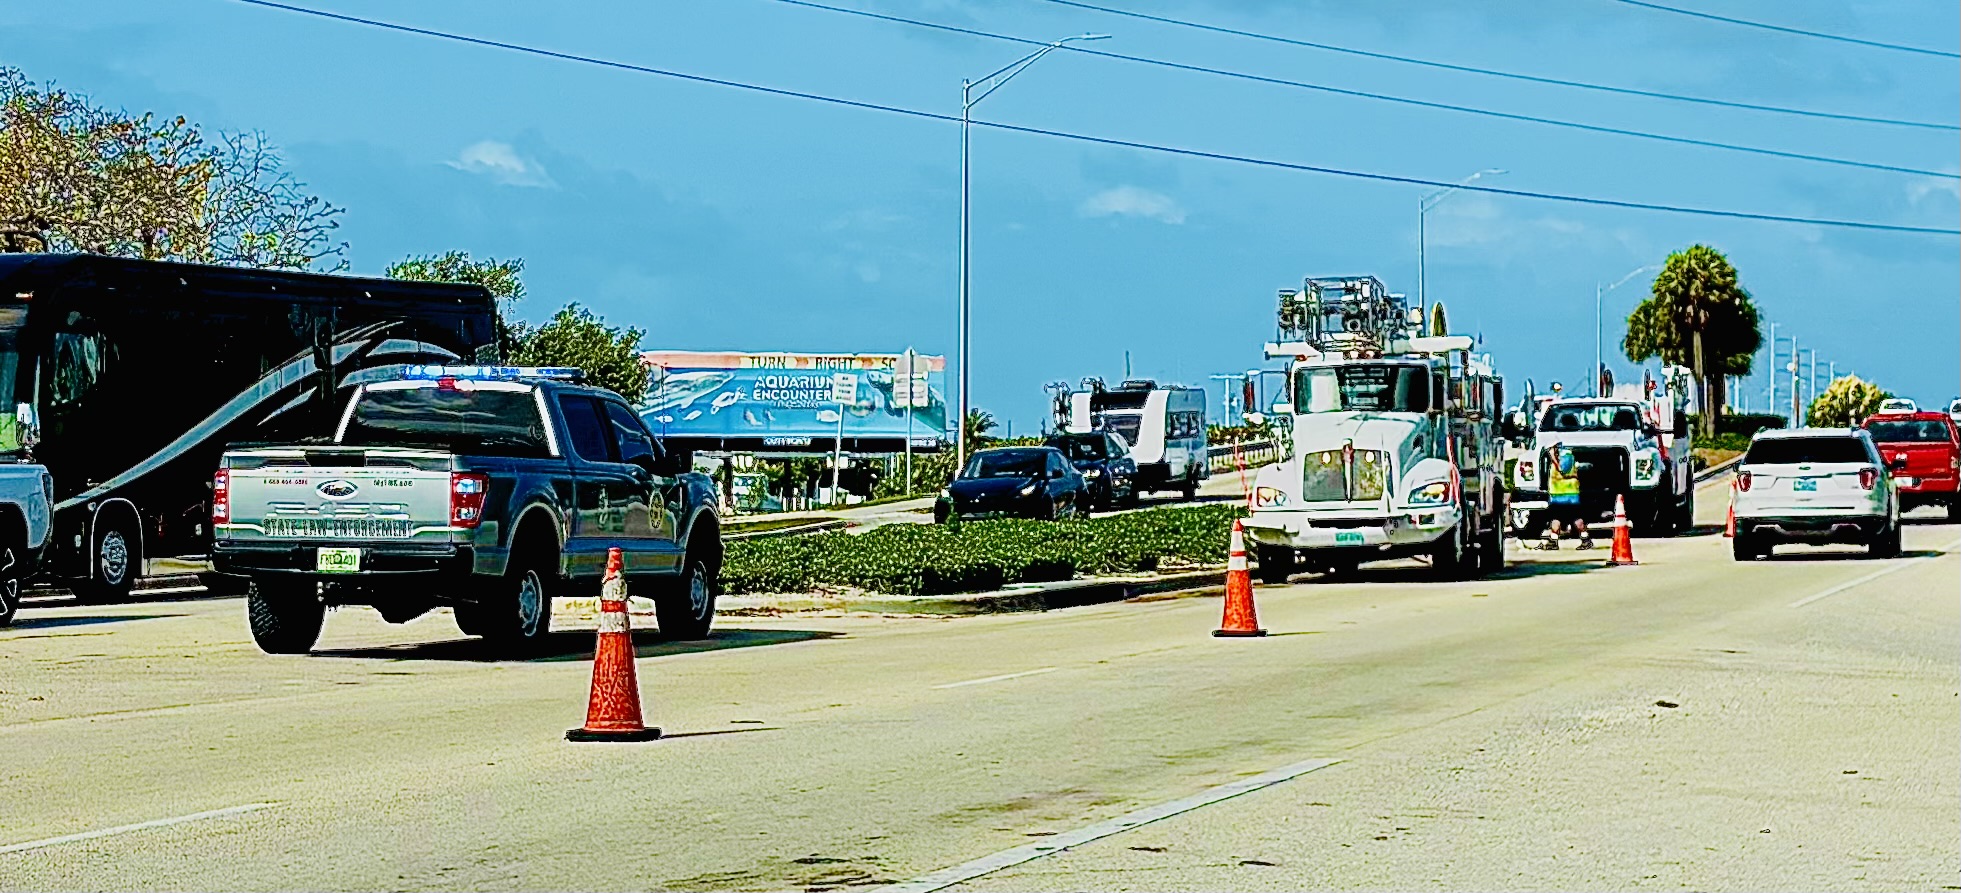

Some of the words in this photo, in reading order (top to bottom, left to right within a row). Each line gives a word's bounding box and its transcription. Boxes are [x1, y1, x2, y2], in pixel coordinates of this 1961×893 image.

[749, 356, 786, 369] TURN
[815, 356, 855, 369] RIGHT
[752, 389, 832, 401] ENCOUNTER
[263, 518, 297, 536] STATE
[303, 518, 328, 537] LAW
[333, 518, 414, 538] ENFORCEMENT
